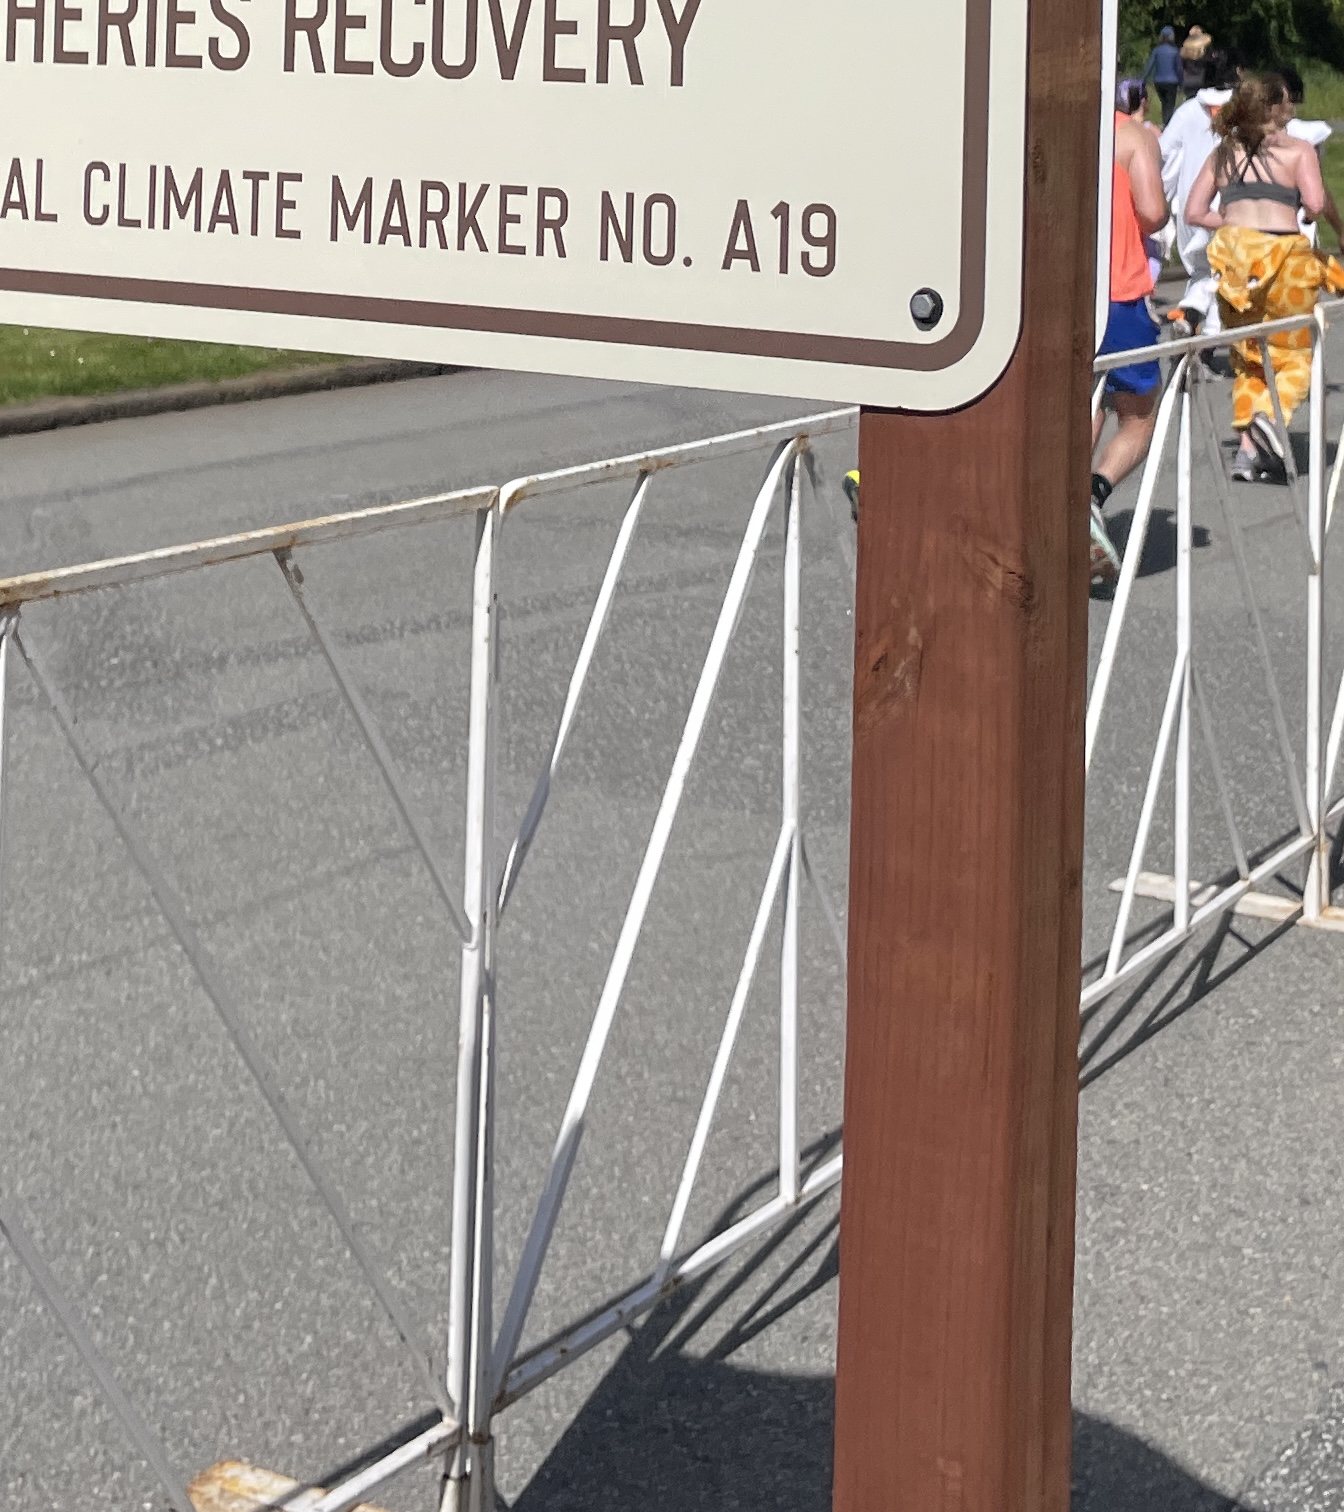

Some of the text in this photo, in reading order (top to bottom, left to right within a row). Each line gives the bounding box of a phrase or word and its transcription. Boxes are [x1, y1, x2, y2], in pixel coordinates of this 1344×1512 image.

[83, 161, 303, 240] CLIMATE
[329, 174, 569, 259] MARKER
[599, 190, 693, 268] NO.
[721, 199, 837, 278] A19
